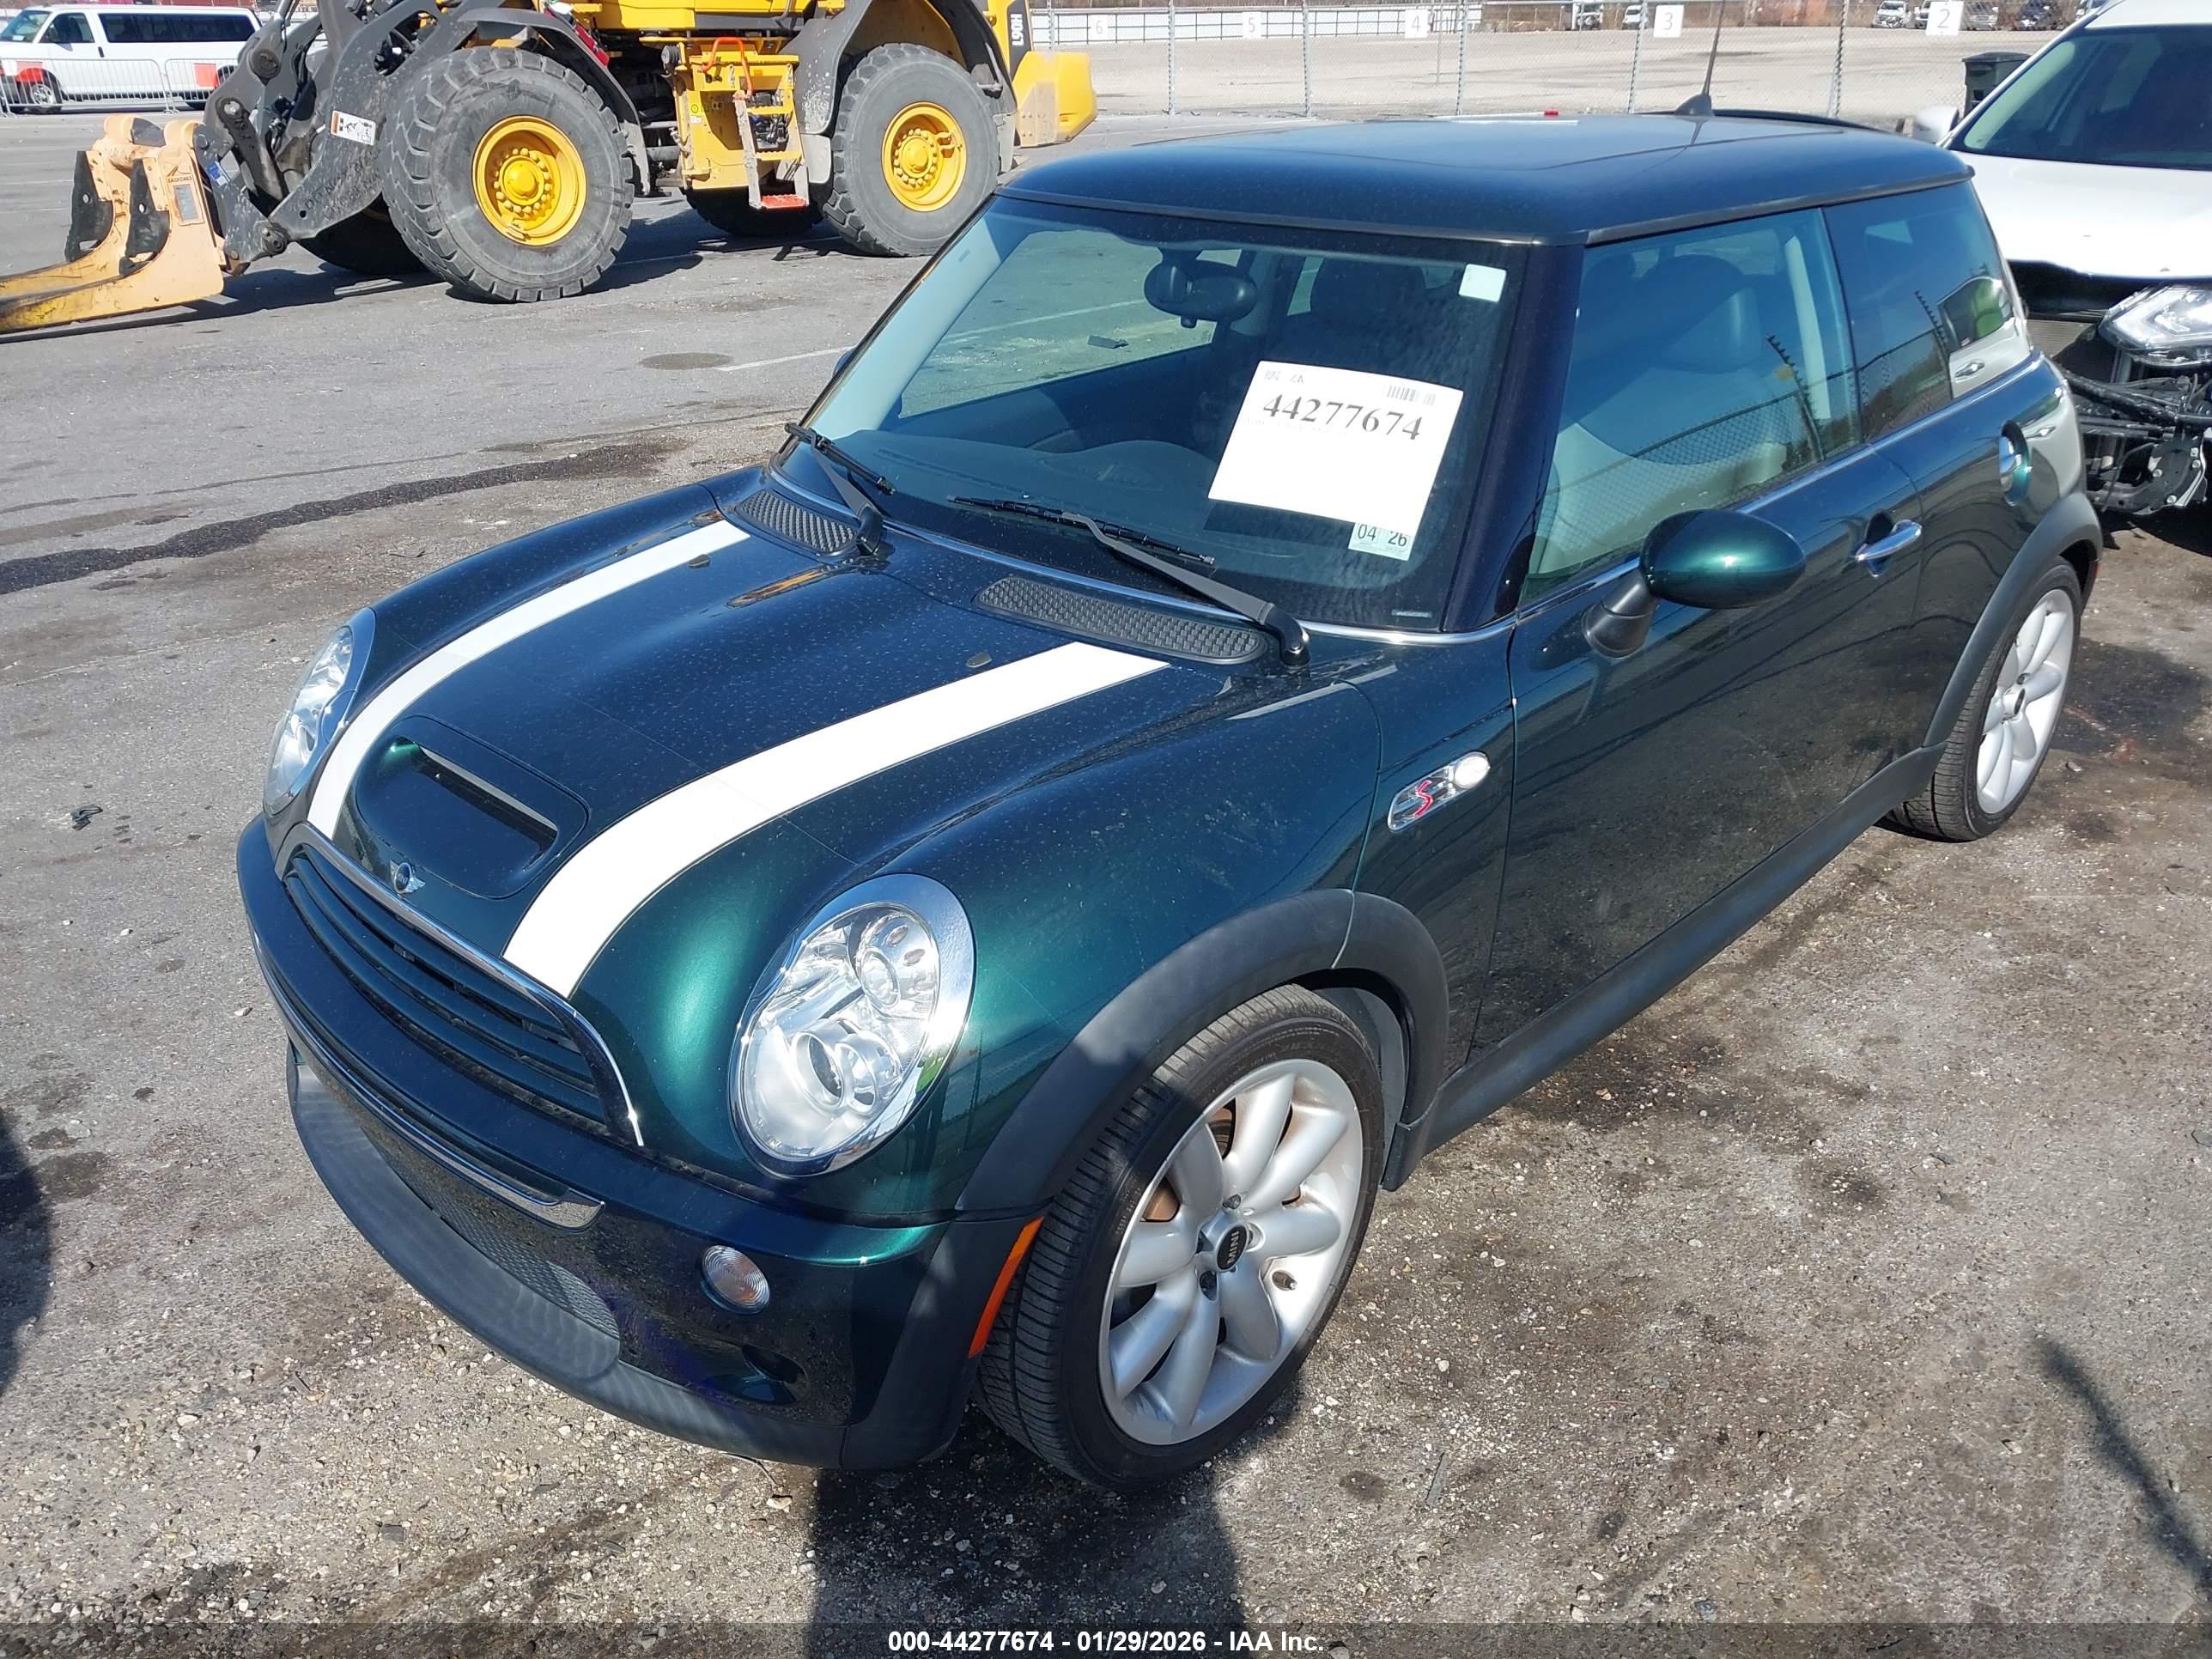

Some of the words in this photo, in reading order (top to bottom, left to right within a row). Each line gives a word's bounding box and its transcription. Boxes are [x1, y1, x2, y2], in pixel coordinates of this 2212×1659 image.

[1096, 20, 1103, 34] 6
[1248, 16, 1256, 33] 5
[1411, 15, 1421, 32] 4
[1662, 12, 1674, 30] 3
[1936, 8, 1951, 28] 2
[1010, 14, 1024, 46] L90H
[1262, 393, 1423, 441] 44277674
[1357, 524, 1377, 542] 04
[1387, 530, 1407, 547] 26
[1414, 779, 1434, 818] S
[1226, 1231, 1240, 1265] MINI
